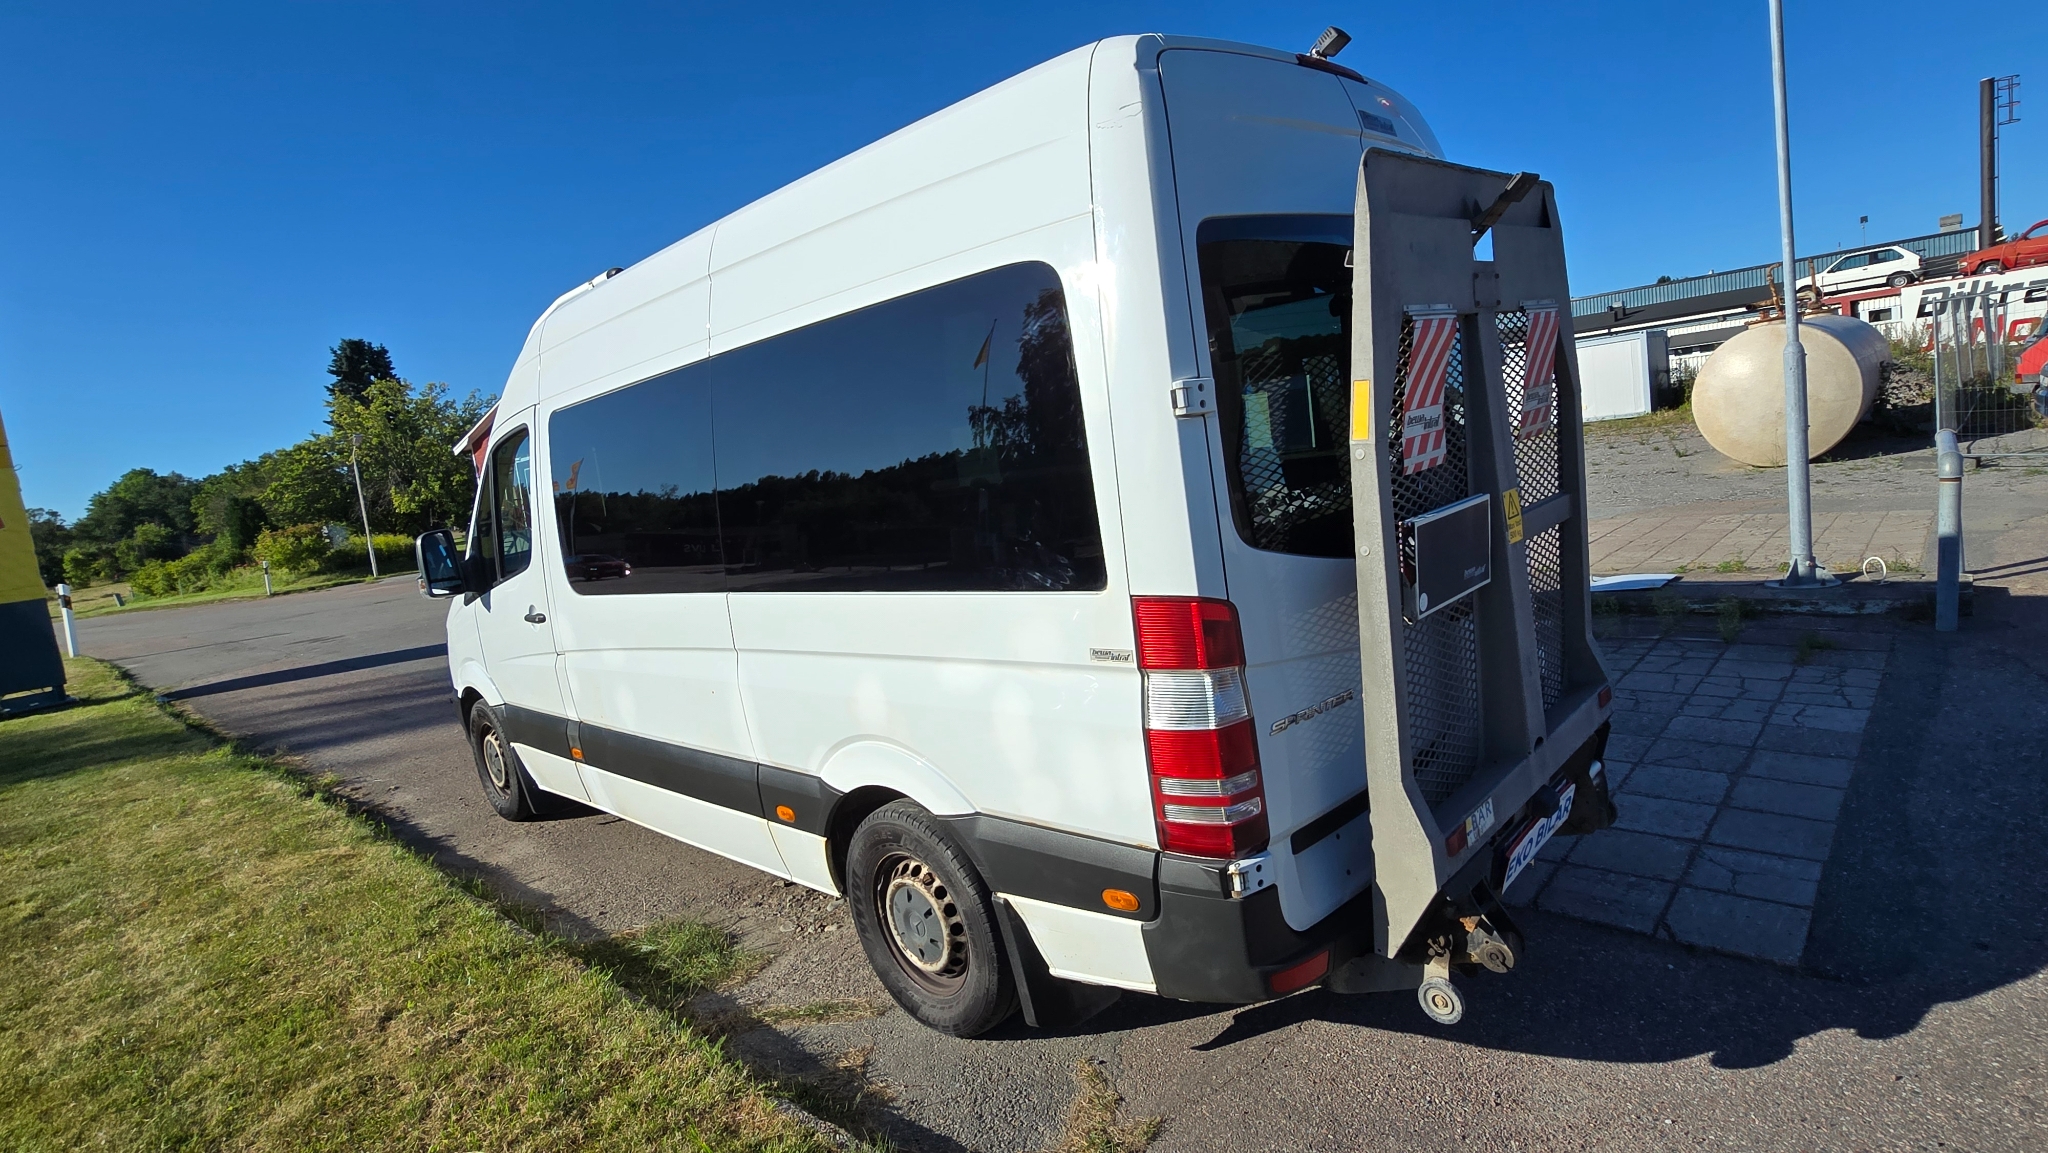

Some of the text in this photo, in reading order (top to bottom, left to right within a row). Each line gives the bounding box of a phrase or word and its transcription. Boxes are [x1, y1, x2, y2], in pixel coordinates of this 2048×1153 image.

[1269, 688, 1355, 737] SPRINTER
[1506, 795, 1573, 883] EKO BILAR
